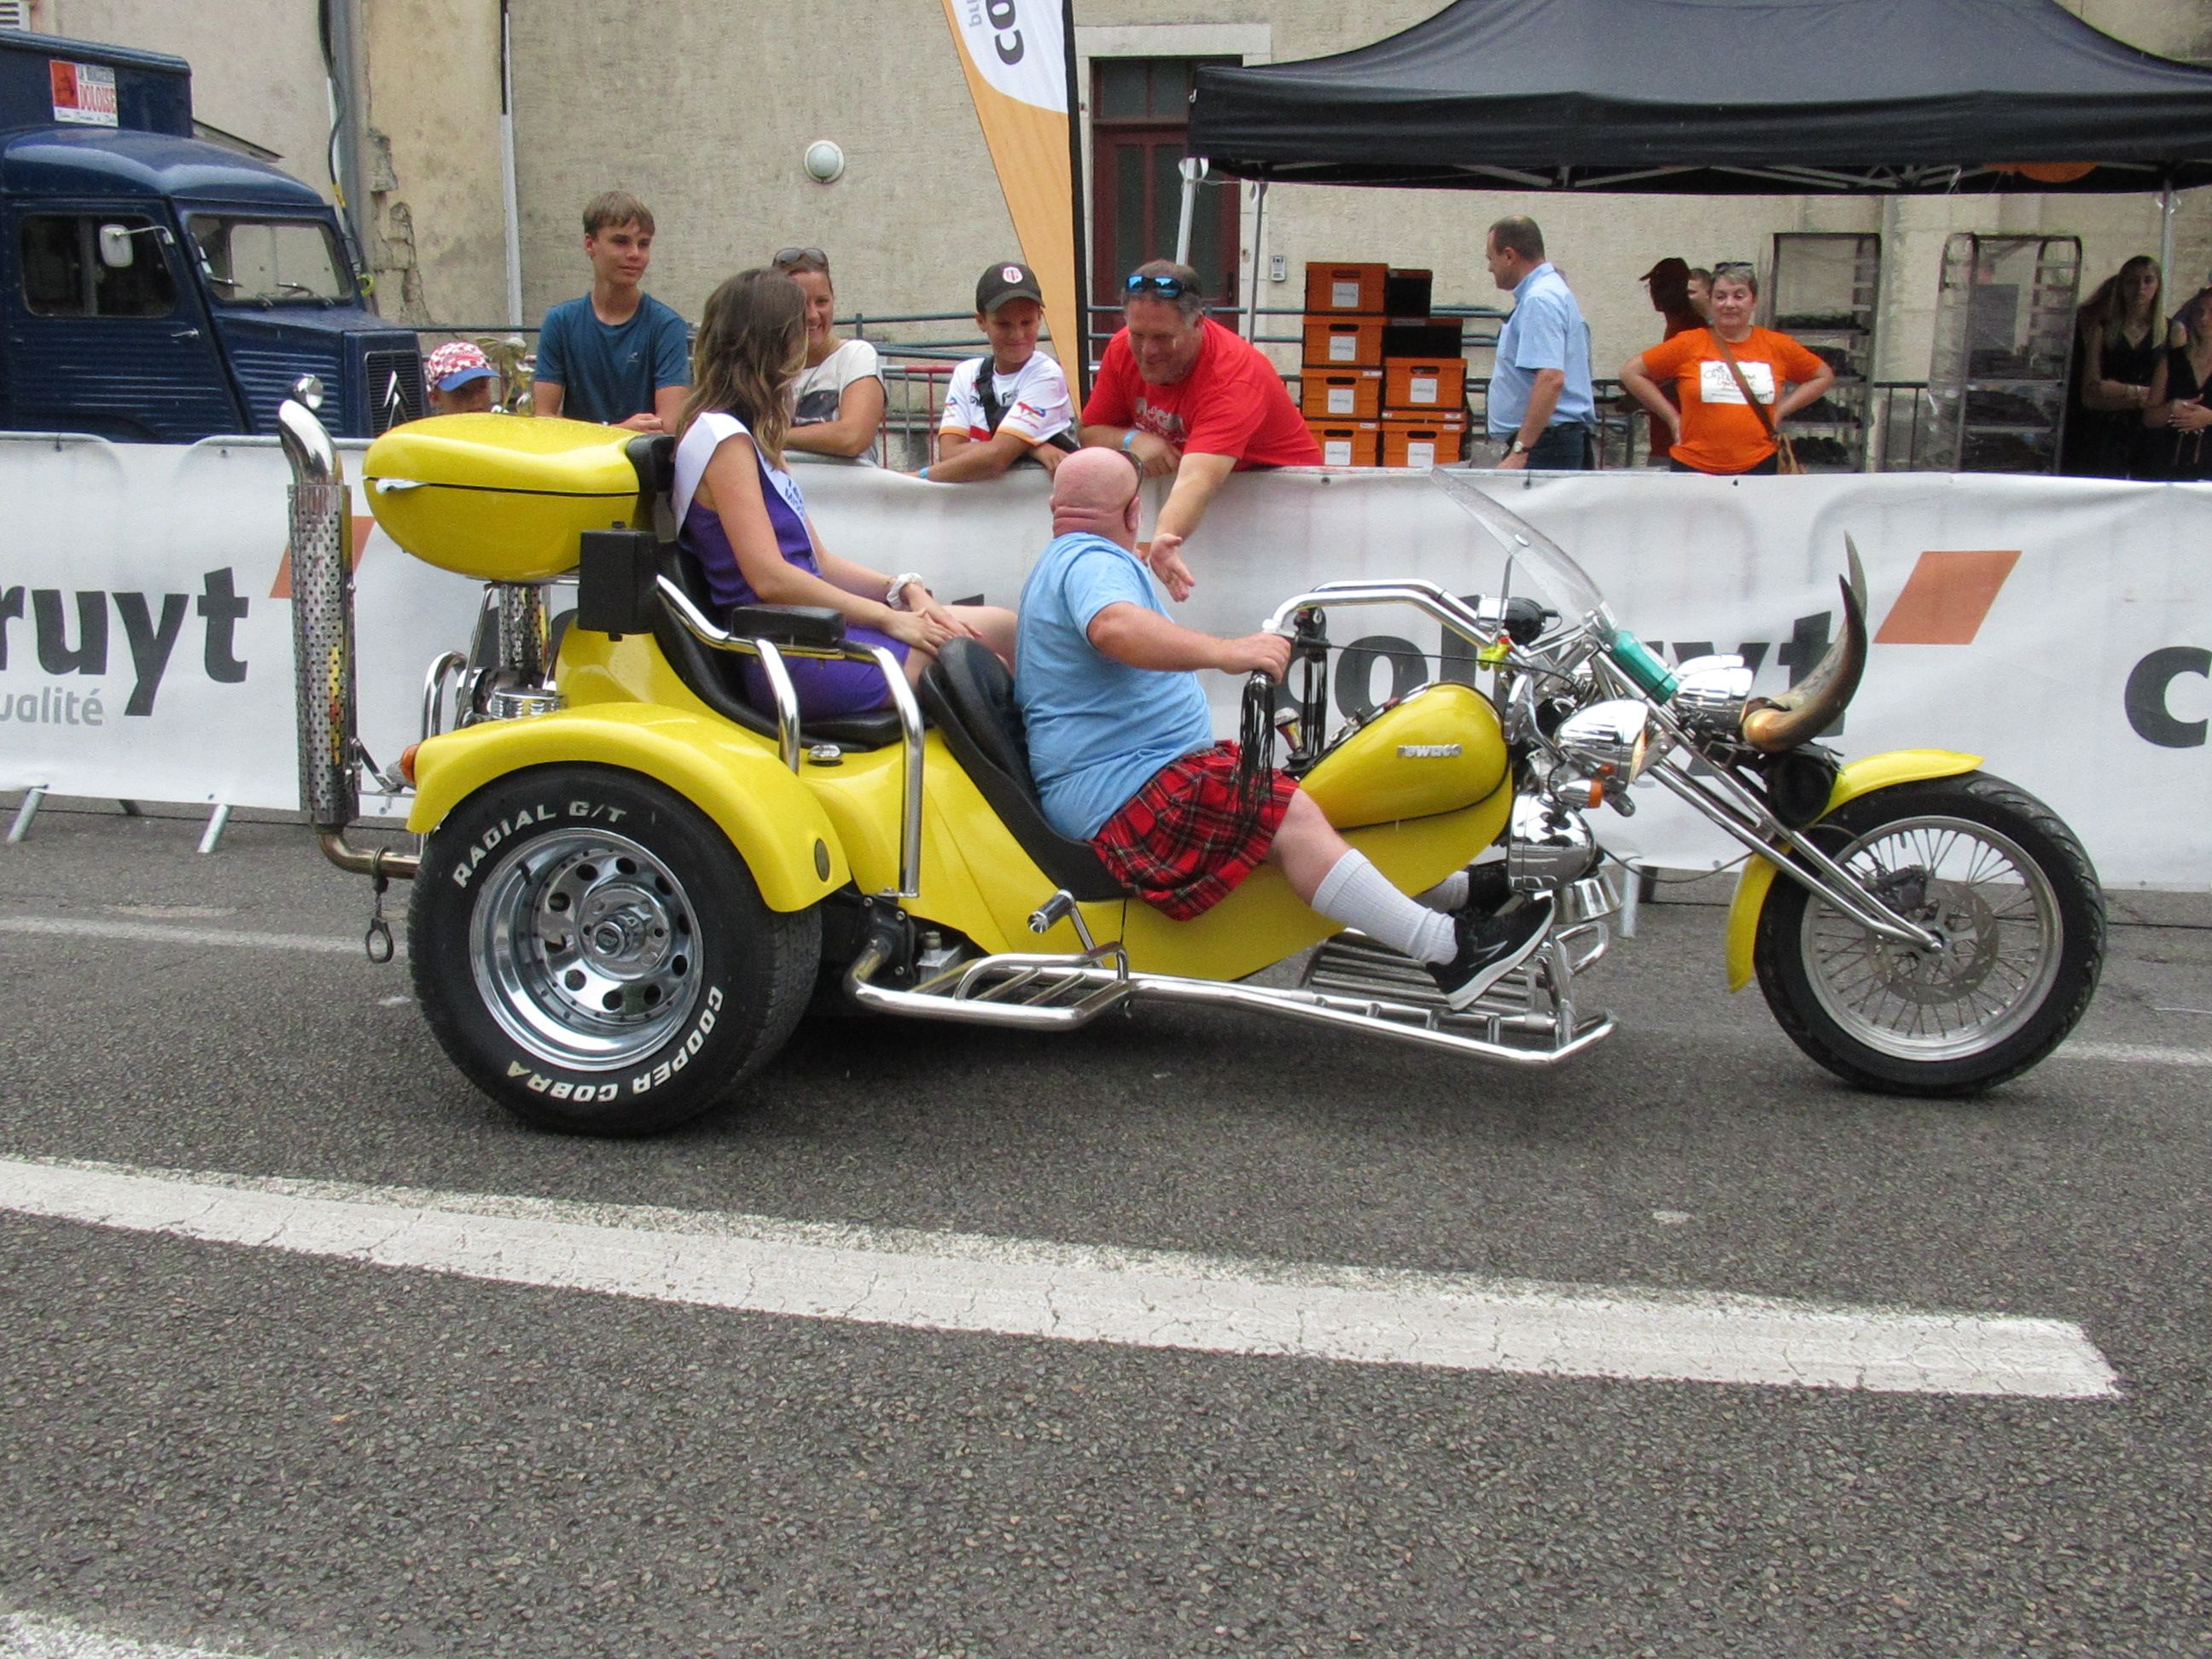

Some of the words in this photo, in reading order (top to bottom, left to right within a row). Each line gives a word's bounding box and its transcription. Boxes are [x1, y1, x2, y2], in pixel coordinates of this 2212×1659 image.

[452, 804, 556, 888] RADIAL
[568, 800, 627, 824] G/T
[506, 1060, 619, 1103] COBRA
[632, 986, 724, 1095] COOPER
